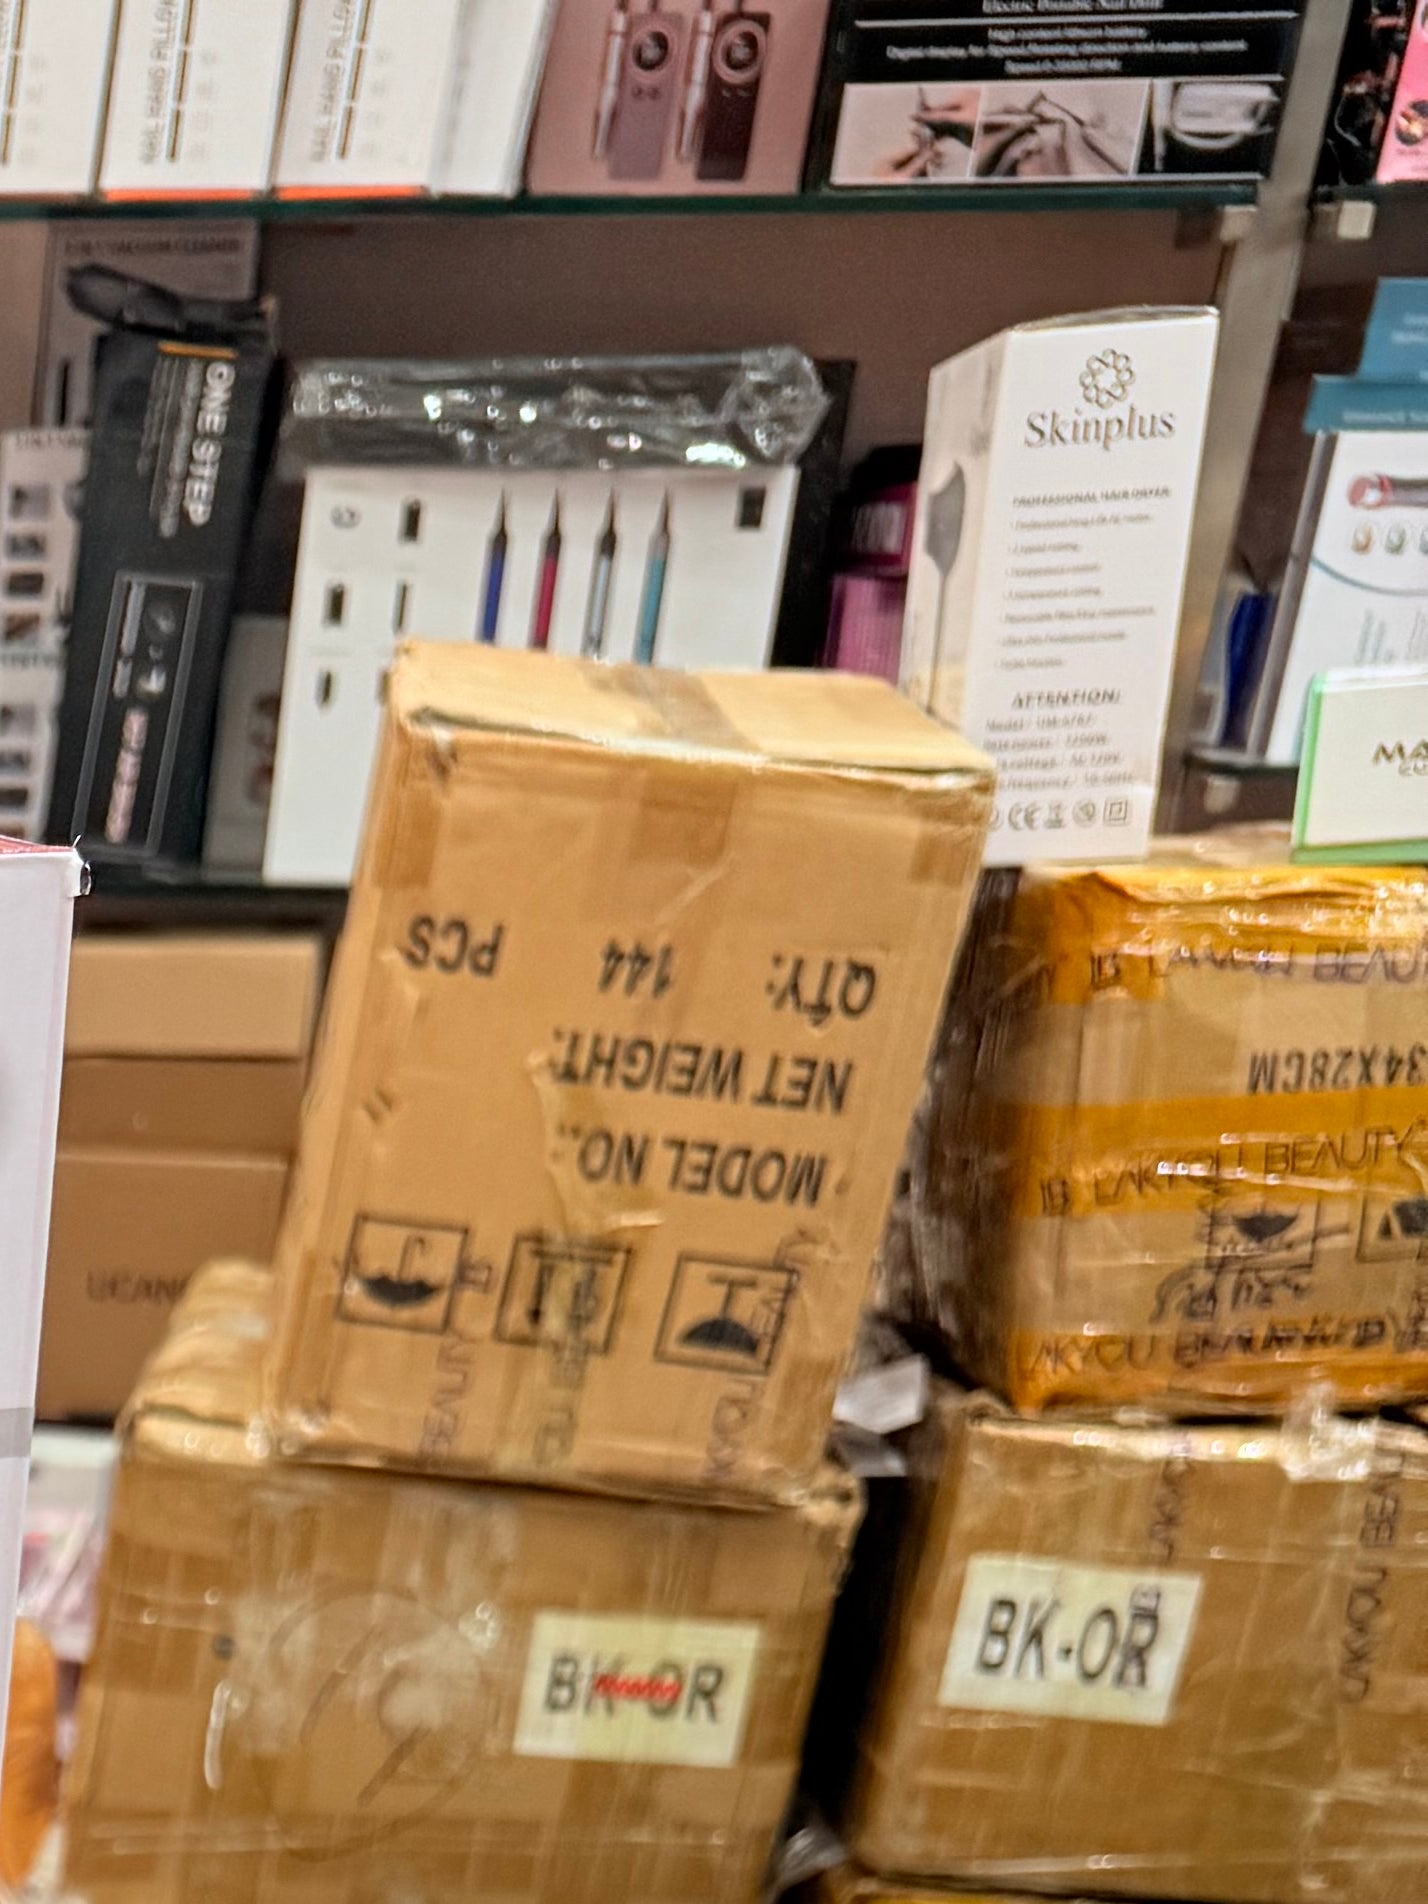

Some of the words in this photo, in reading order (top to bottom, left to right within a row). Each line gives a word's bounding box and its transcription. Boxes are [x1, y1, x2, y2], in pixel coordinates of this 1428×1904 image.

[1024, 404, 1177, 451] Skinplus
[405, 914, 507, 979] PCS
[598, 938, 675, 995] 144
[754, 1057, 854, 1116] NET
[663, 1140, 830, 1207] MODEL
